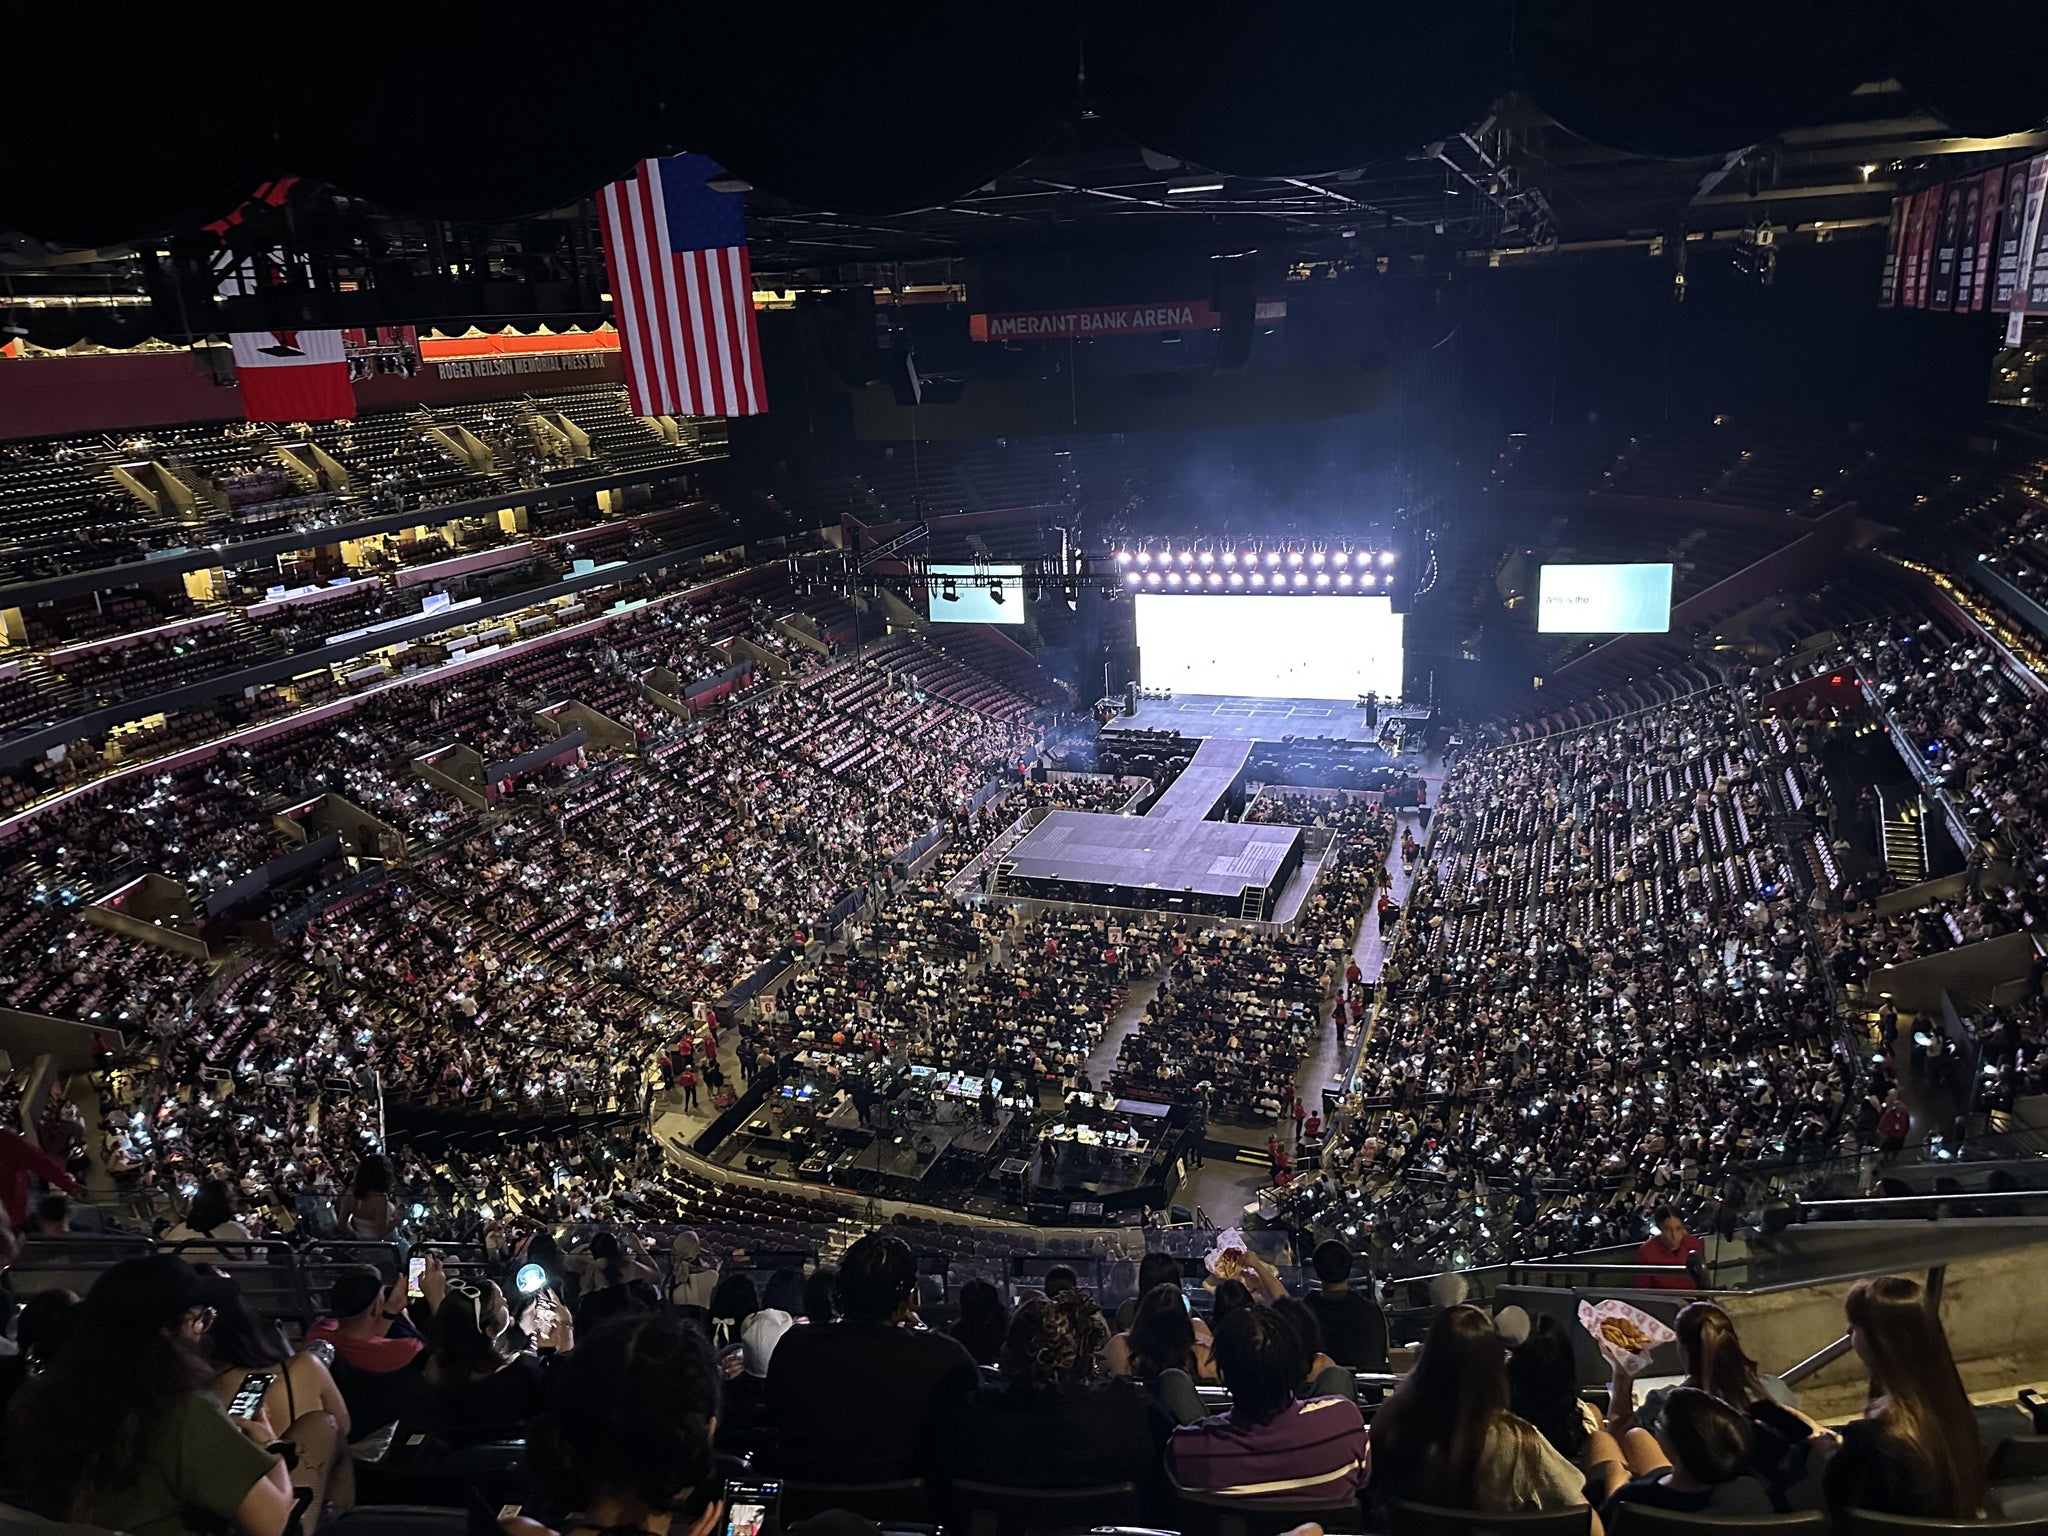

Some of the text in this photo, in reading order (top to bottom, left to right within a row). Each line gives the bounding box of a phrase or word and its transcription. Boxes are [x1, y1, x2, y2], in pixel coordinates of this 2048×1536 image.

[990, 306, 1194, 335] AMERANT BANK ARENA
[438, 353, 606, 380] ROGER NEILSON MEMORIAL PRESS BOX
[1111, 933, 1118, 943] 2
[764, 1002, 772, 1013] 6
